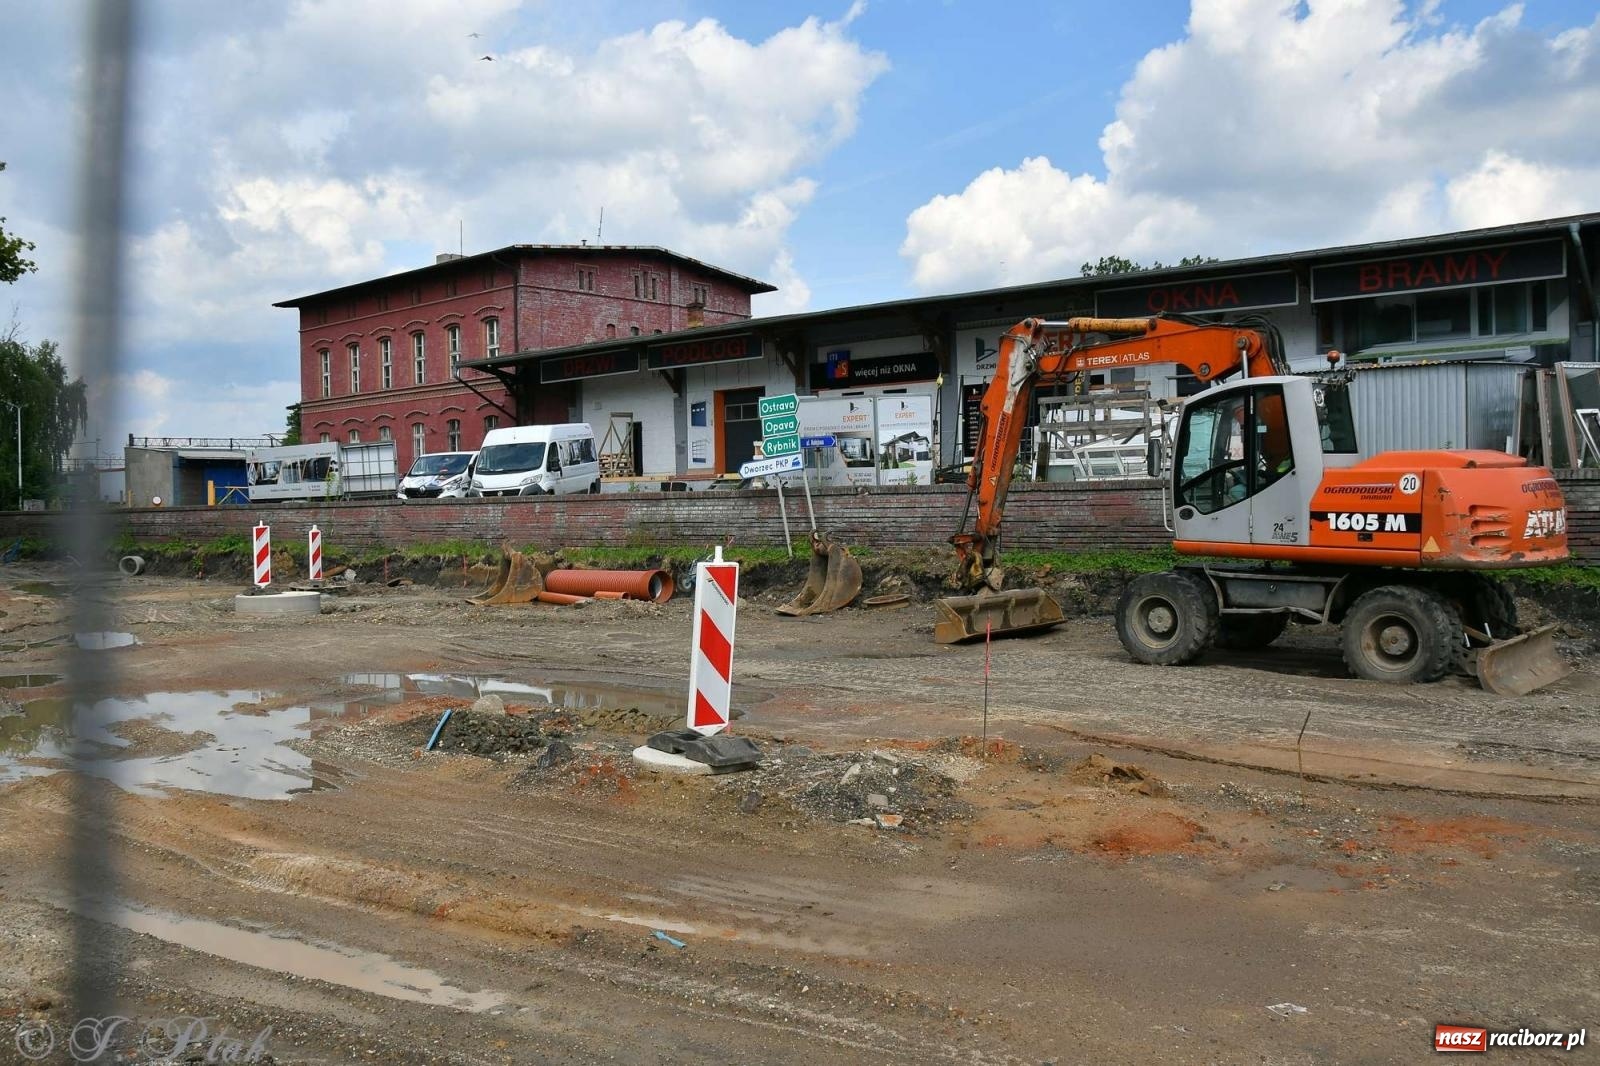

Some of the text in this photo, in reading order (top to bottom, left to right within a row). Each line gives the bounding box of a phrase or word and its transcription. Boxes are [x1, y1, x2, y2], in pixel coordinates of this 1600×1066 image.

[1359, 251, 1509, 292] BRAMY
[1146, 282, 1240, 312] OKNA
[1087, 352, 1150, 366] TEREX ATLAS
[855, 366, 878, 378] więcej
[893, 363, 917, 373] OKNA
[761, 401, 795, 413] Ostrava
[842, 414, 867, 423] EXPERT
[765, 421, 794, 434] Opava
[767, 439, 796, 453] Rybnik
[744, 458, 789, 475] Dworzec PKP
[1323, 486, 1395, 495] OGRODOWSKI
[1402, 477, 1416, 491] 20
[1327, 512, 1407, 532] 1605 M
